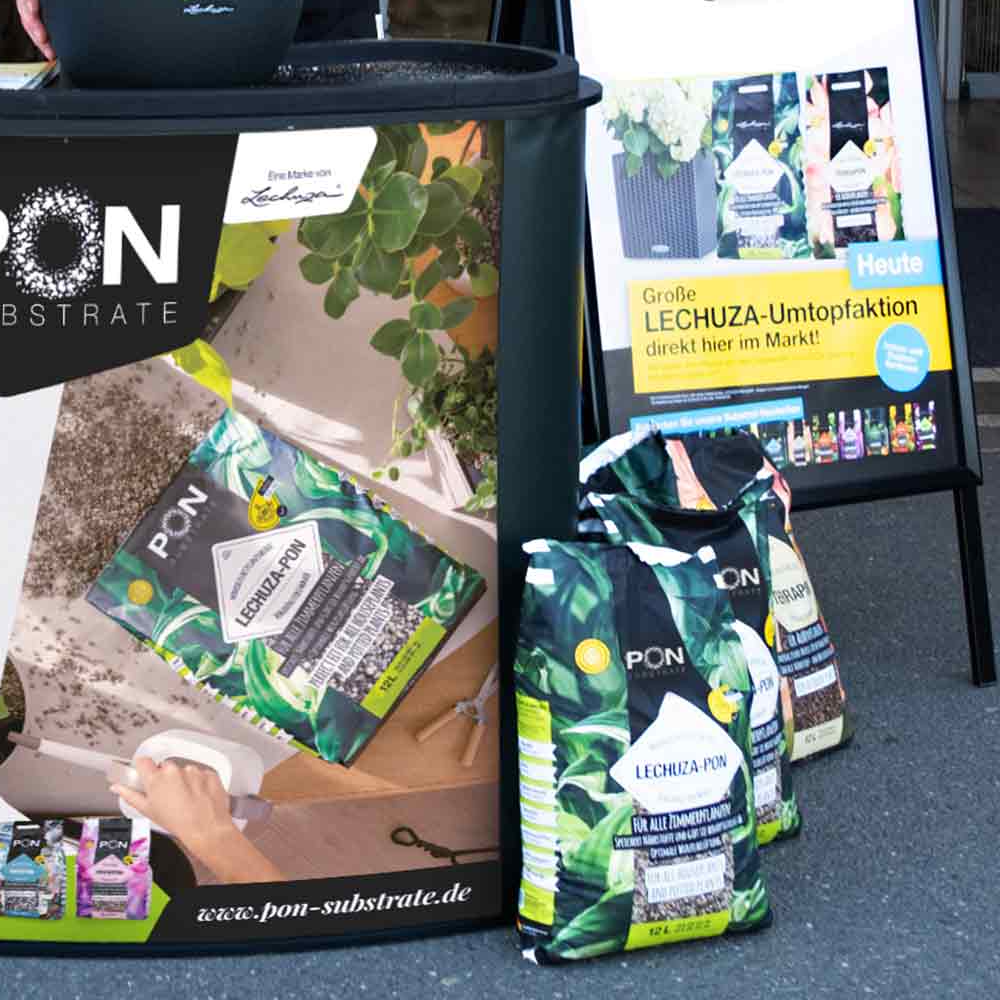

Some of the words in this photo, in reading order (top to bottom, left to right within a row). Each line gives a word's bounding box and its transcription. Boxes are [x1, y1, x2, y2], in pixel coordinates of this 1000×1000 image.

[857, 252, 923, 277] Heute
[643, 286, 696, 304] Große
[645, 296, 919, 333] LECHUZA-Umtopfaktion
[646, 335, 697, 357] direkt
[702, 333, 734, 353] hier
[740, 333, 760, 350] im
[765, 330, 820, 348] Markt!
[148, 483, 208, 560] PON
[234, 538, 307, 629] LECHUZA-PON
[713, 567, 760, 590] ON
[626, 645, 686, 669] PON
[635, 754, 728, 780] LECHUZA-PON
[197, 882, 472, 923] www.pon-substrate.de
